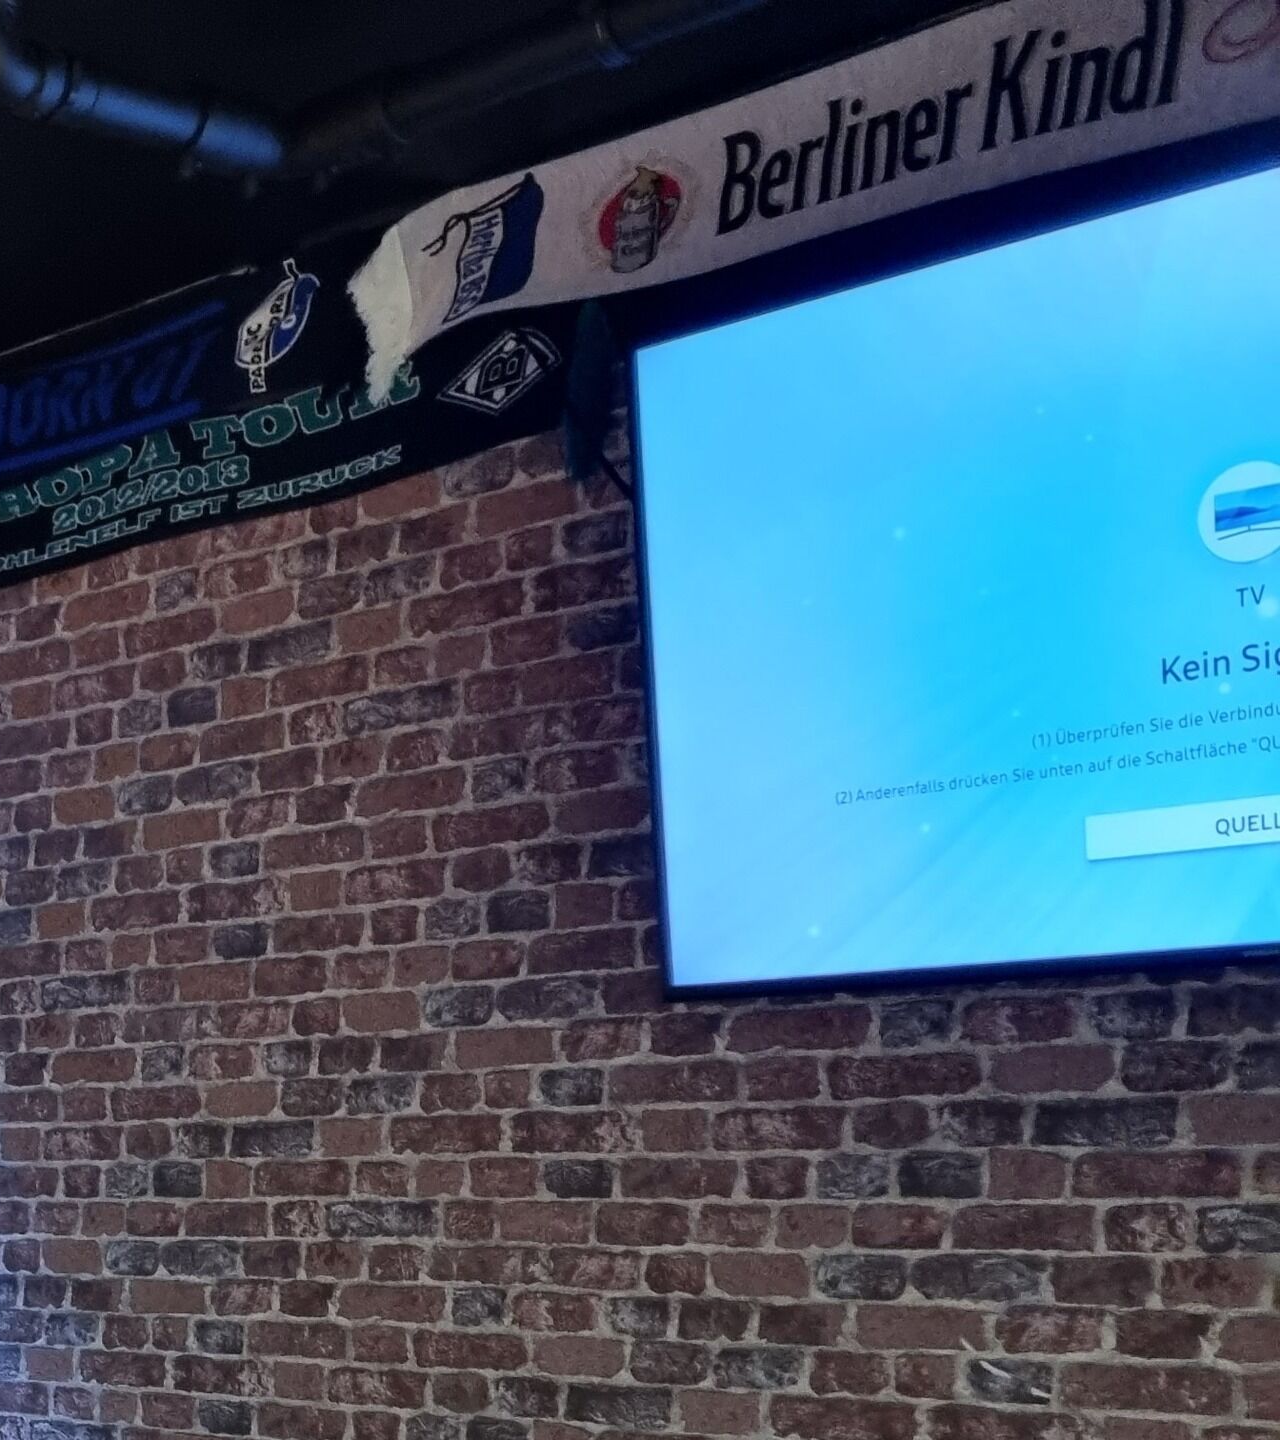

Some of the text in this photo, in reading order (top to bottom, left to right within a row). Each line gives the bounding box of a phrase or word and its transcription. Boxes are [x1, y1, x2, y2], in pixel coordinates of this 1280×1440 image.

[715, 0, 1185, 236] Berliner Kindl
[52, 453, 251, 536] 2012/2013
[169, 493, 229, 524] IST
[1236, 584, 1266, 608] TV
[1161, 652, 1231, 685] Kein
[1032, 733, 1052, 751] (1)
[1055, 721, 1145, 747] Überprüfen
[1150, 716, 1174, 734] Sie
[1178, 712, 1204, 730] die
[856, 779, 946, 802] Anderenfalls
[949, 769, 1008, 792] drücken
[1012, 766, 1035, 783] Sie
[1040, 761, 1084, 780] unten
[1088, 756, 1114, 774] auf
[1117, 751, 1142, 770] die
[1145, 741, 1248, 768] Schaltfläche
